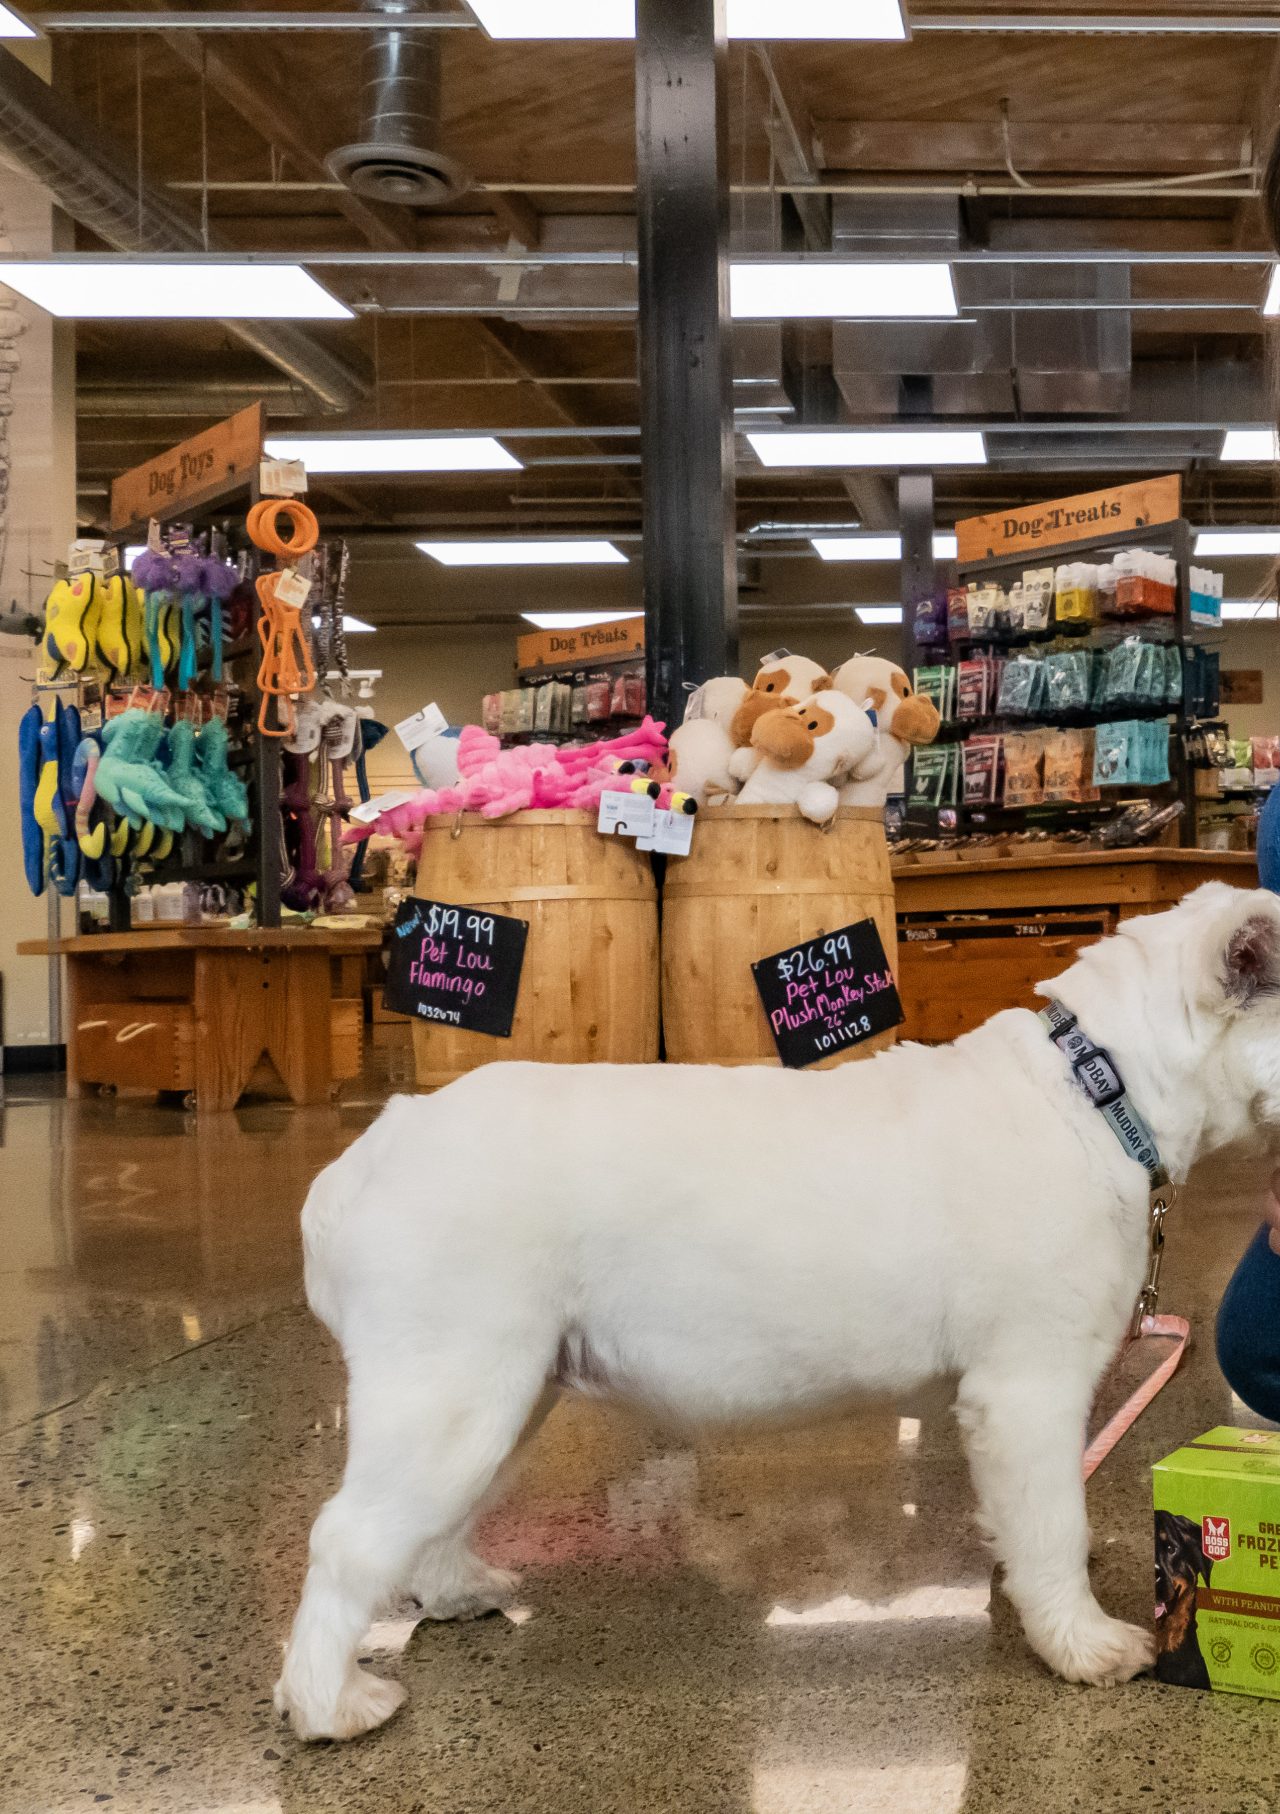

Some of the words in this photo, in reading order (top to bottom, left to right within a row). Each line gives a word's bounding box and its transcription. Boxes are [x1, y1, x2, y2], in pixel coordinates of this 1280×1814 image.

[149, 468, 176, 496] Dog
[179, 448, 214, 482] Toys
[1003, 518, 1044, 539] Dog
[1047, 500, 1121, 530] Treats
[549, 637, 577, 653] Dog
[581, 627, 628, 648] Treats
[423, 904, 495, 945] $19.99
[420, 937, 448, 964] Pet
[456, 945, 495, 970] Lou
[777, 934, 853, 982] $26.99
[409, 961, 486, 1005] Flamingo
[785, 975, 819, 1005] Pet
[770, 999, 818, 1036] Plush
[863, 970, 894, 994] Stick
[814, 1015, 872, 1051] 1011128
[1073, 1045, 1113, 1096] MDBAY
[1108, 1100, 1145, 1151] MUDBAY
[1205, 1536, 1229, 1547] BOSS
[1208, 1545, 1226, 1556] DOG
[1212, 1595, 1239, 1607] WITH
[1241, 1600, 1280, 1613] PEANUT
[1208, 1616, 1242, 1628] NATURAL
[1243, 1621, 1260, 1630] DOG
